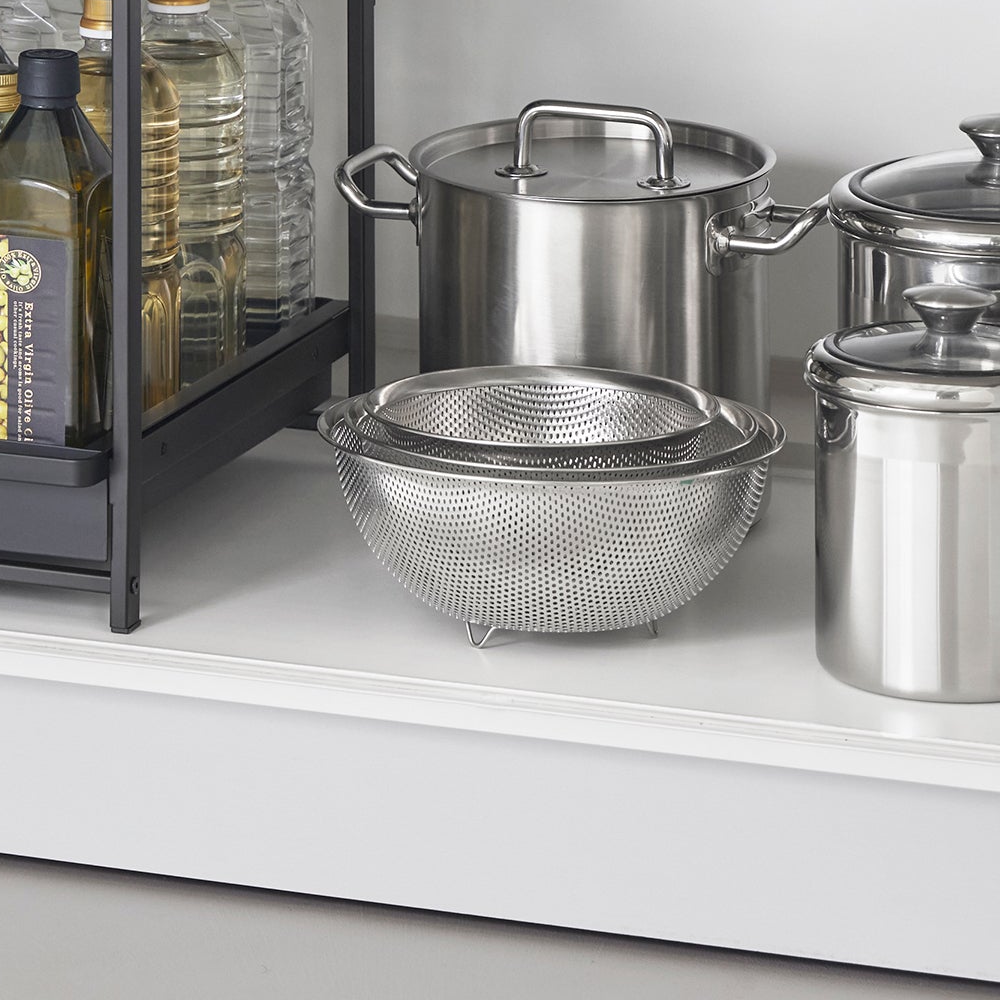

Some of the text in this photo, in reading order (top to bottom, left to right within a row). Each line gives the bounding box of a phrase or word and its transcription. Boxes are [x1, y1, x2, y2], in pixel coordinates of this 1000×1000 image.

[22, 302, 34, 442] Extra Virgin Olive Oi
